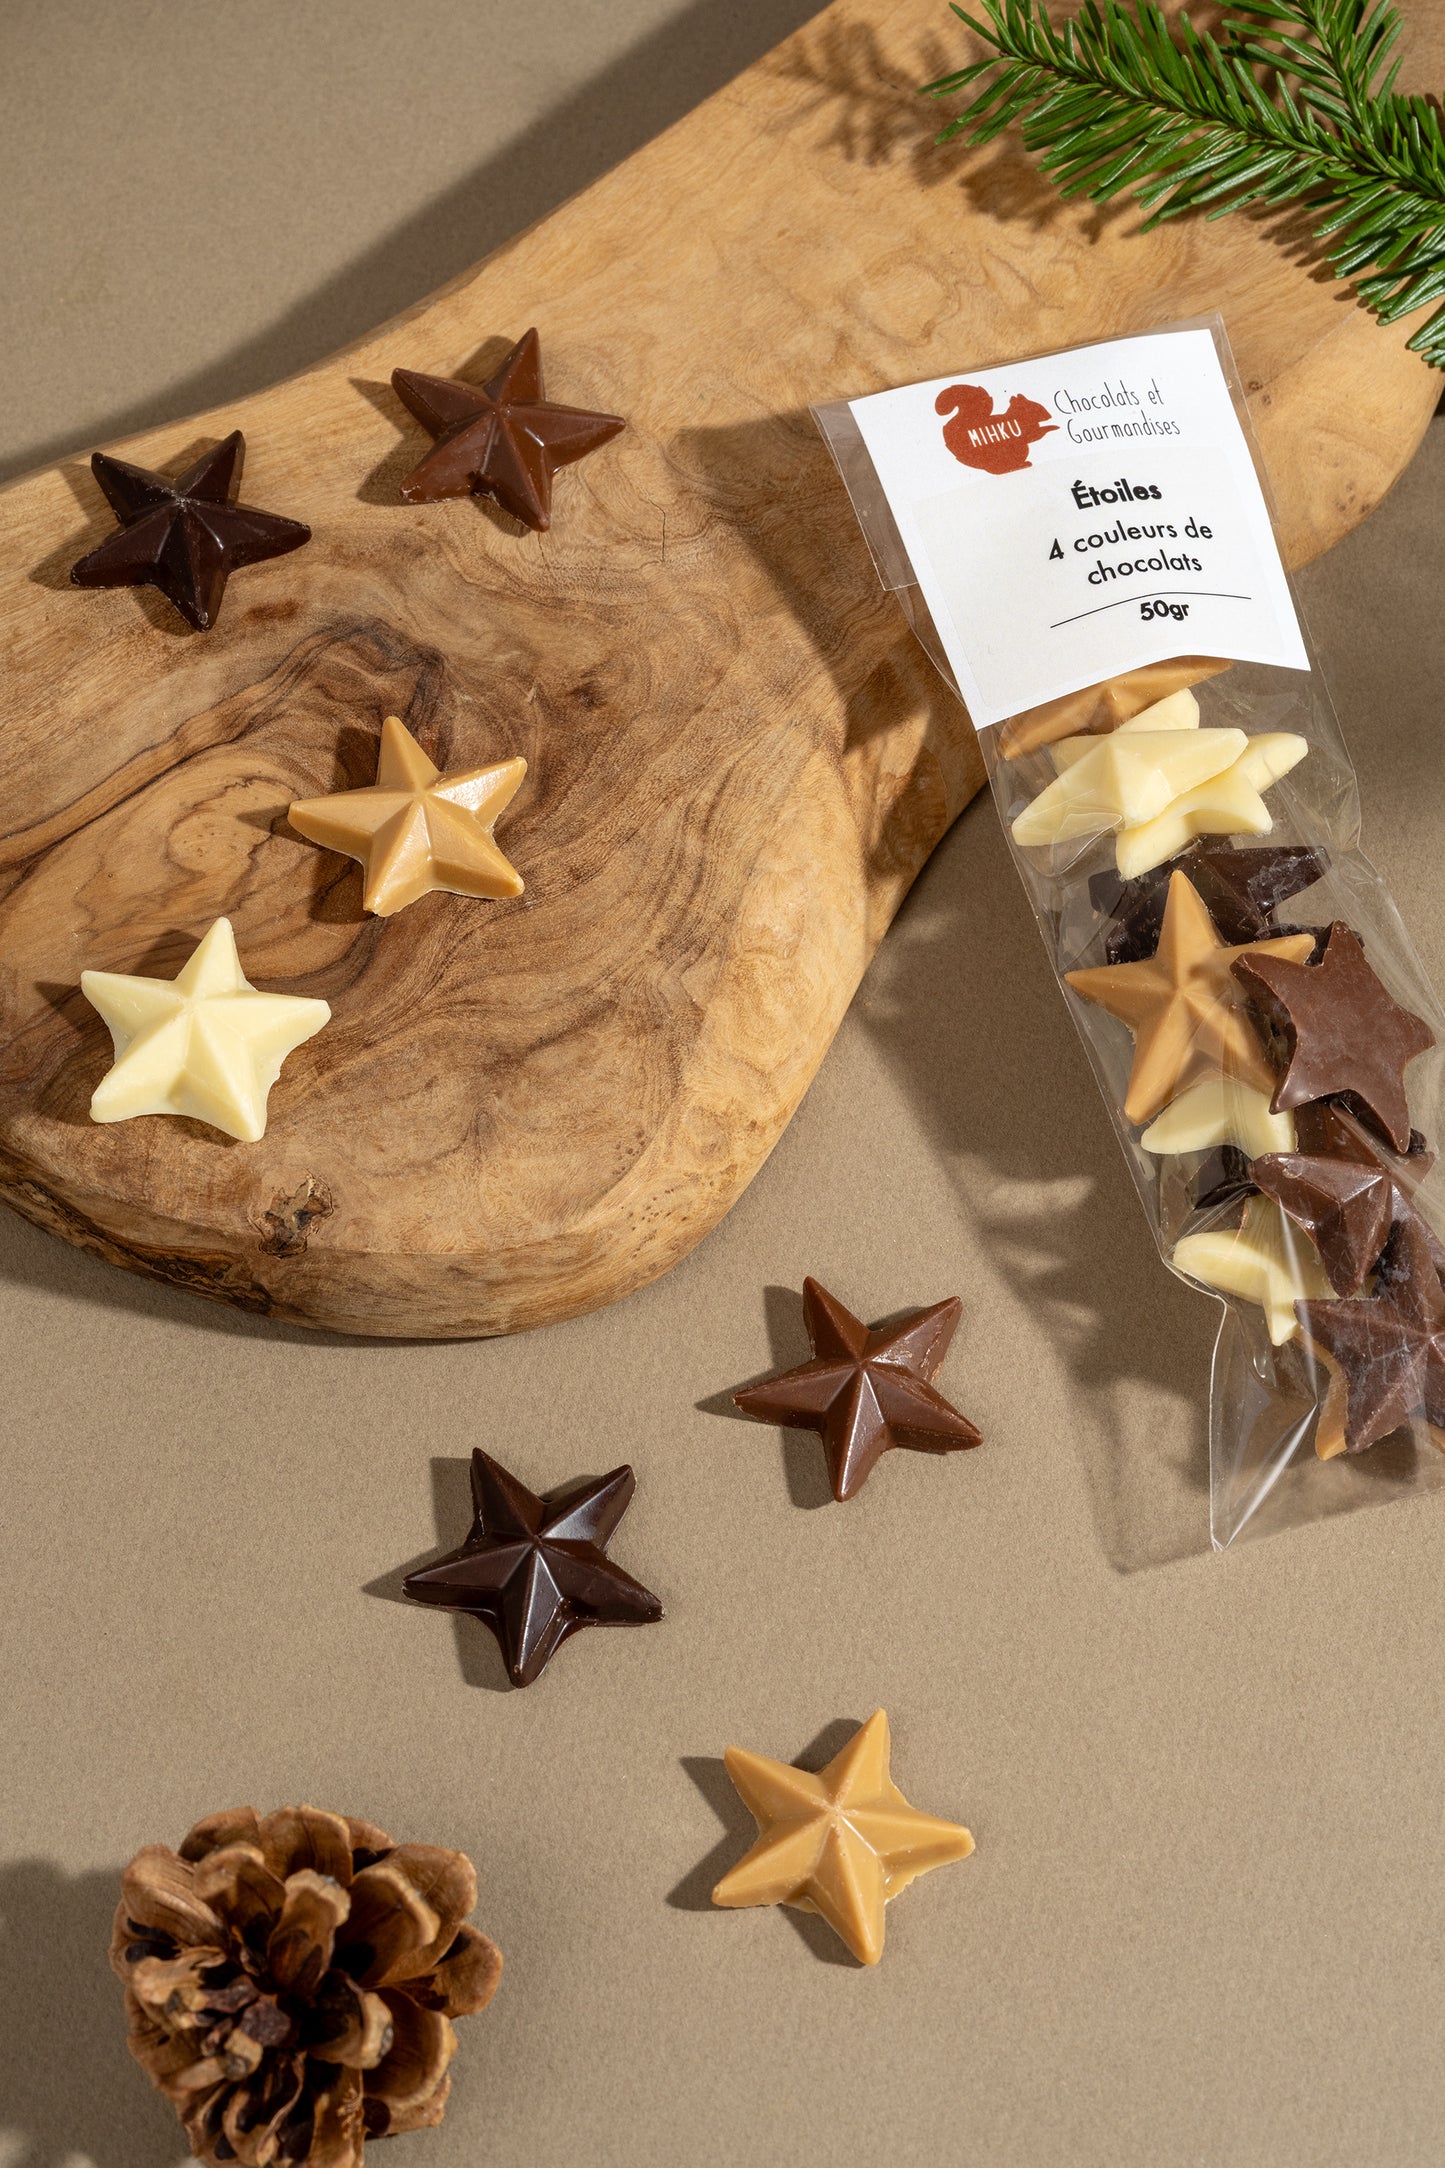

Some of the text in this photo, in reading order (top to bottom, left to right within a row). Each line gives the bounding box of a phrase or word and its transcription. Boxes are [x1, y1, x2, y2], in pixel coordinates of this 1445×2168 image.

[1053, 378, 1165, 415] Chocolats et
[967, 419, 1022, 448] MIHKU
[1066, 410, 1181, 445] Gourmandises
[1071, 478, 1163, 510] Étoiles
[1049, 516, 1213, 561] 4 couleurs de
[1087, 549, 1203, 586] chocolats
[1140, 600, 1190, 622] 50gr
